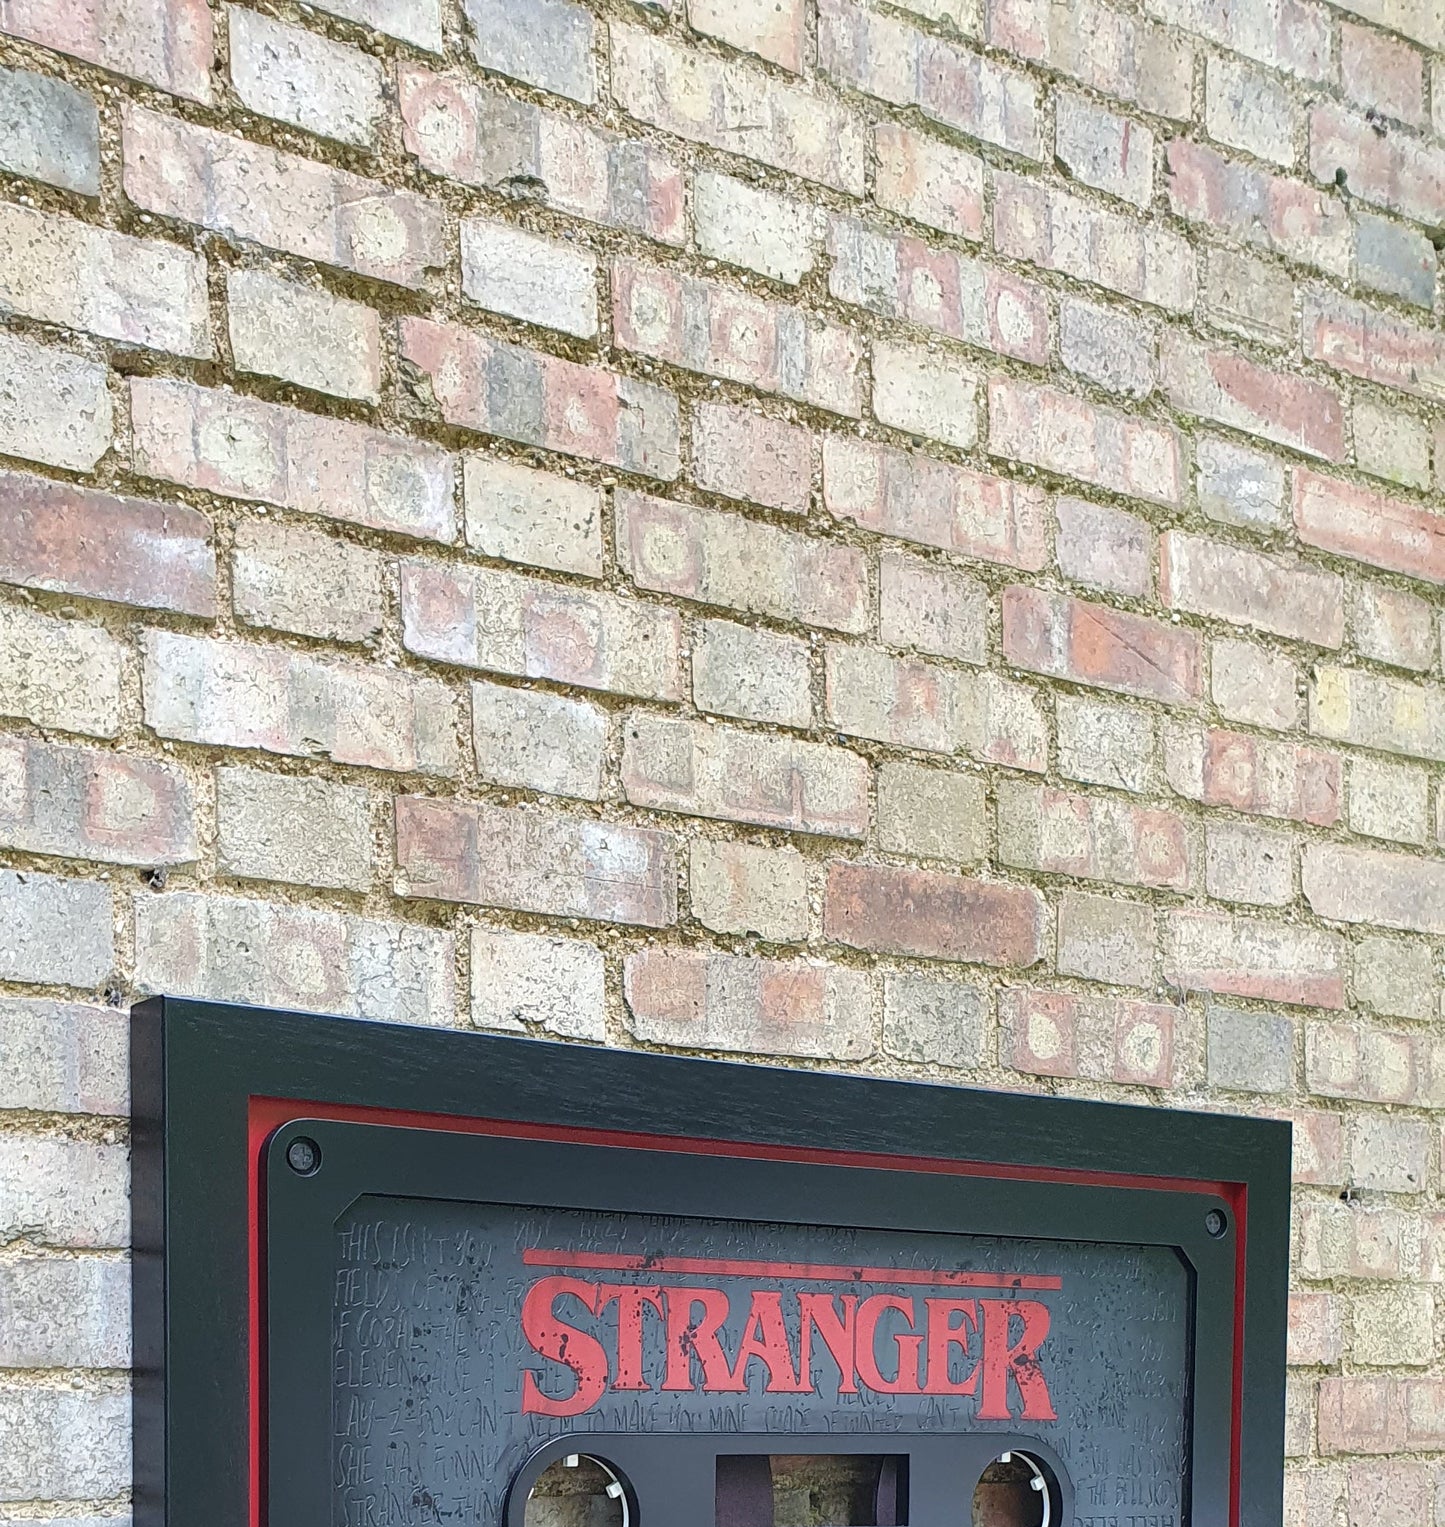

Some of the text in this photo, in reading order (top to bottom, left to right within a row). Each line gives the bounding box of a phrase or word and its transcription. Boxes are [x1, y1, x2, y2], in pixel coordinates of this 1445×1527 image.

[337, 1220, 384, 1266] THIS
[334, 1348, 414, 1389] ELEVEN
[520, 1275, 1058, 1422] STRANGER
[335, 1441, 375, 1489] SHE
